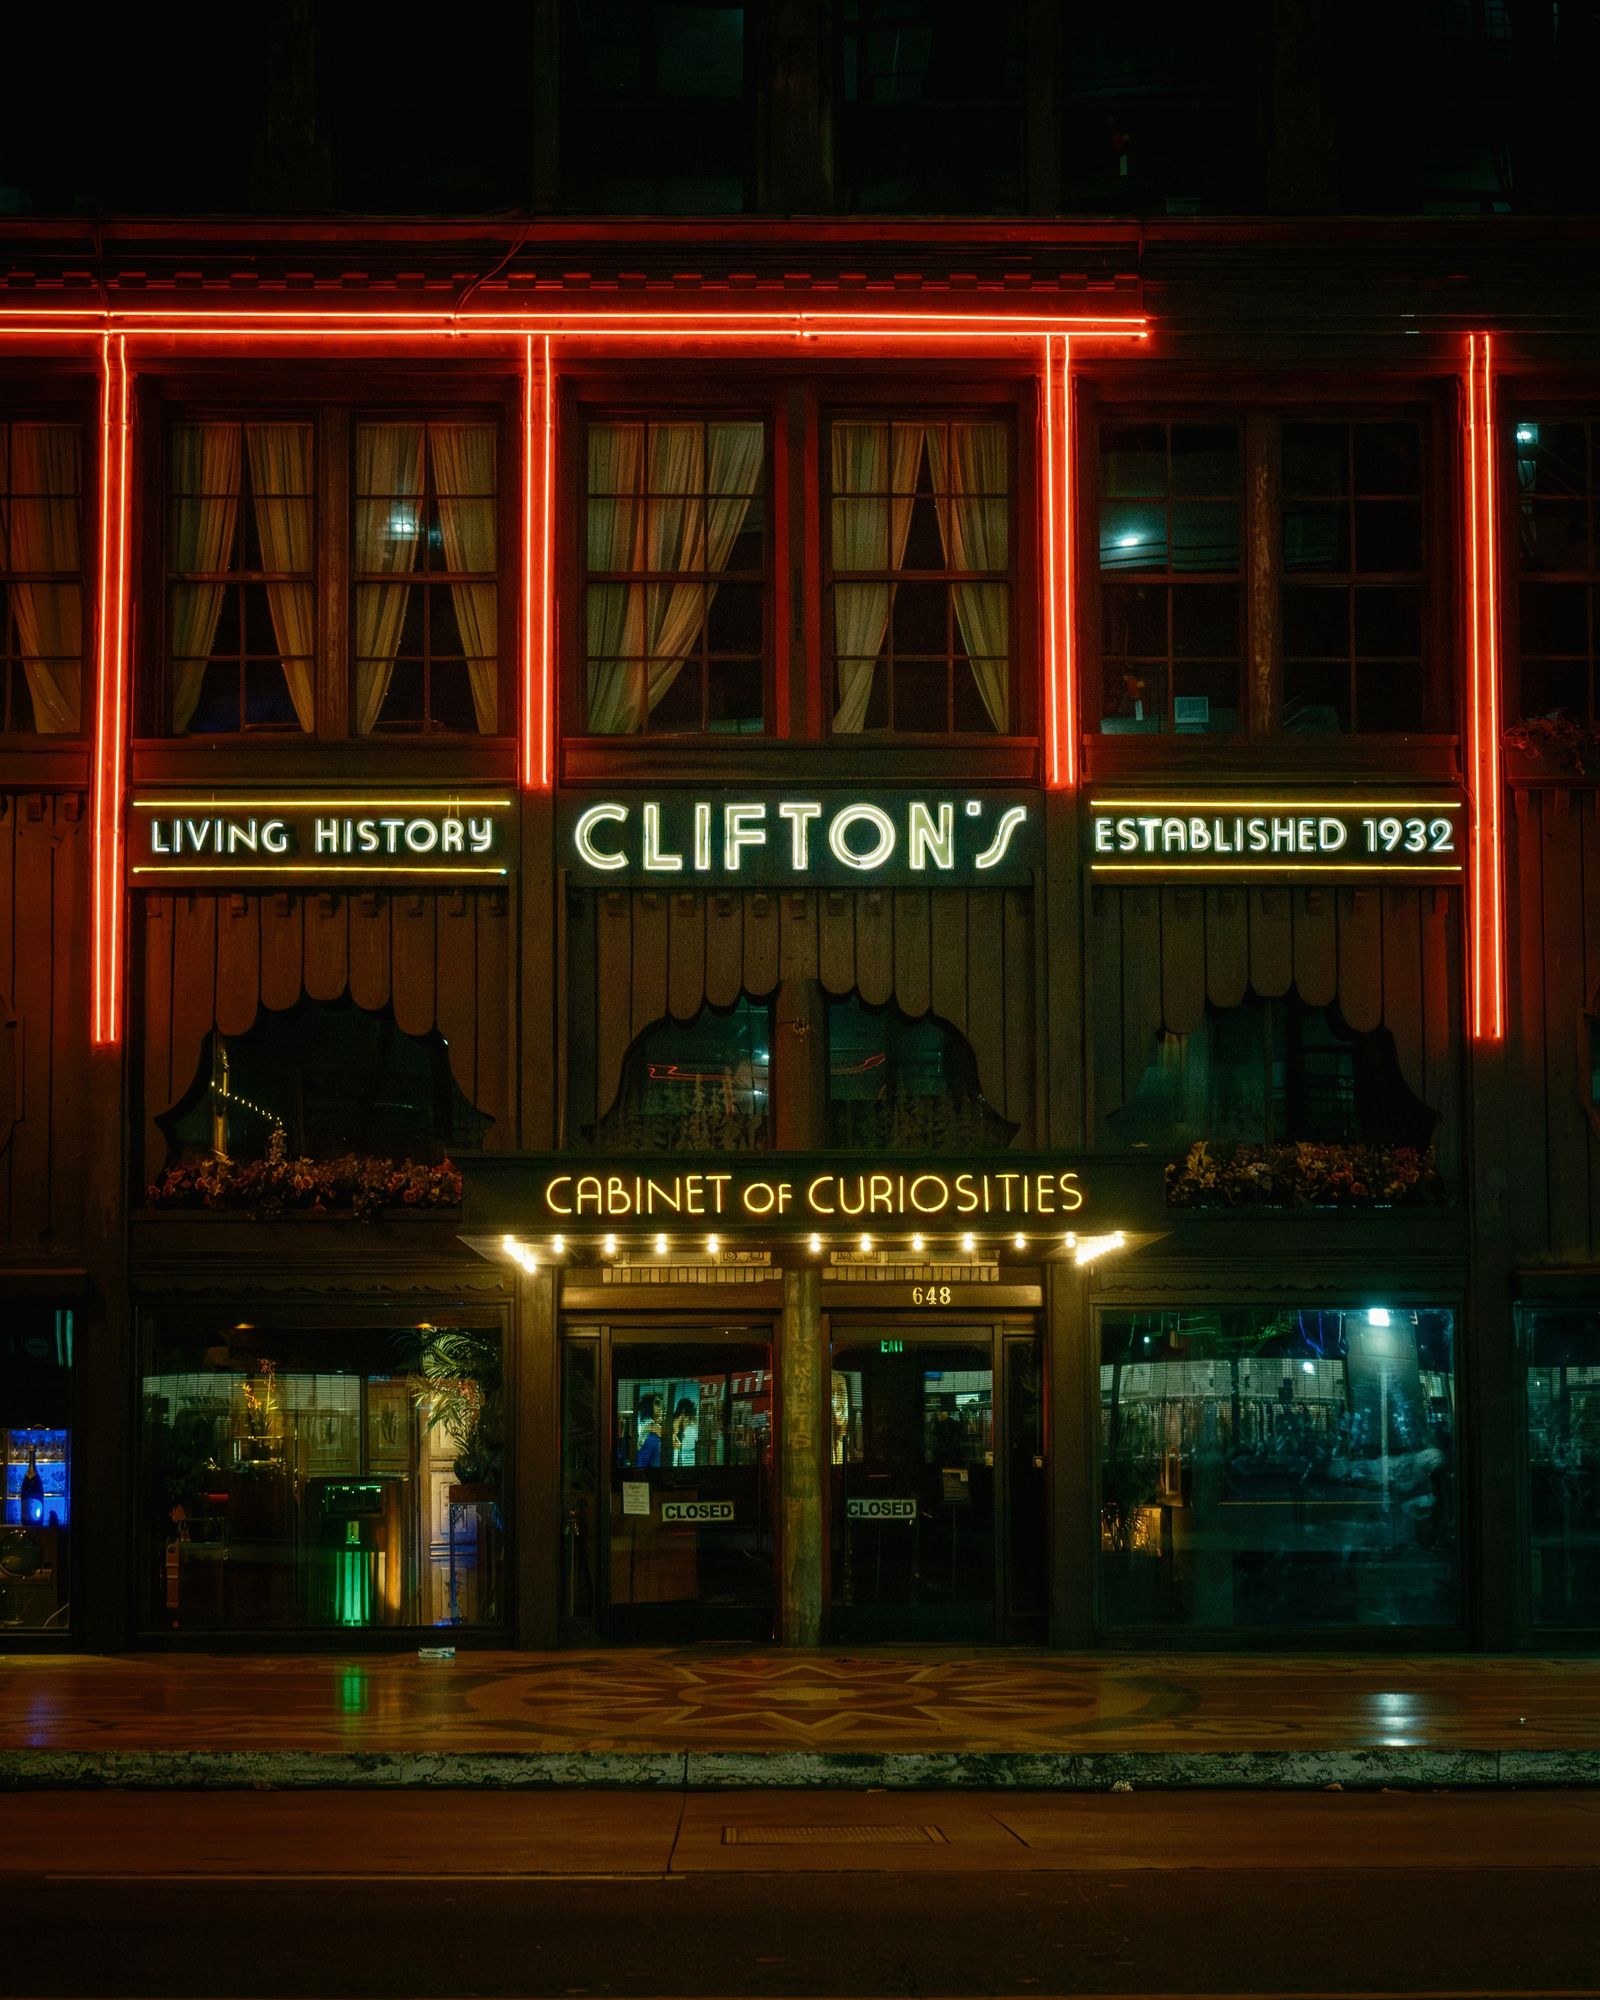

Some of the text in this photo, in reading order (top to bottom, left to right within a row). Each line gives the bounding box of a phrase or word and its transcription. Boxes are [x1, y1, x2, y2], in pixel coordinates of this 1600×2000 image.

[151, 816, 494, 854] LIVING HISTORY
[574, 800, 1028, 871] CLIFTON'S
[1094, 816, 1455, 853] ESTABLISHED 1932
[545, 1173, 1084, 1215] CABINET OF CURIOSITIES
[911, 1285, 952, 1306] 648
[664, 1504, 732, 1520] CLOSED
[847, 1501, 915, 1516] CLOSED
